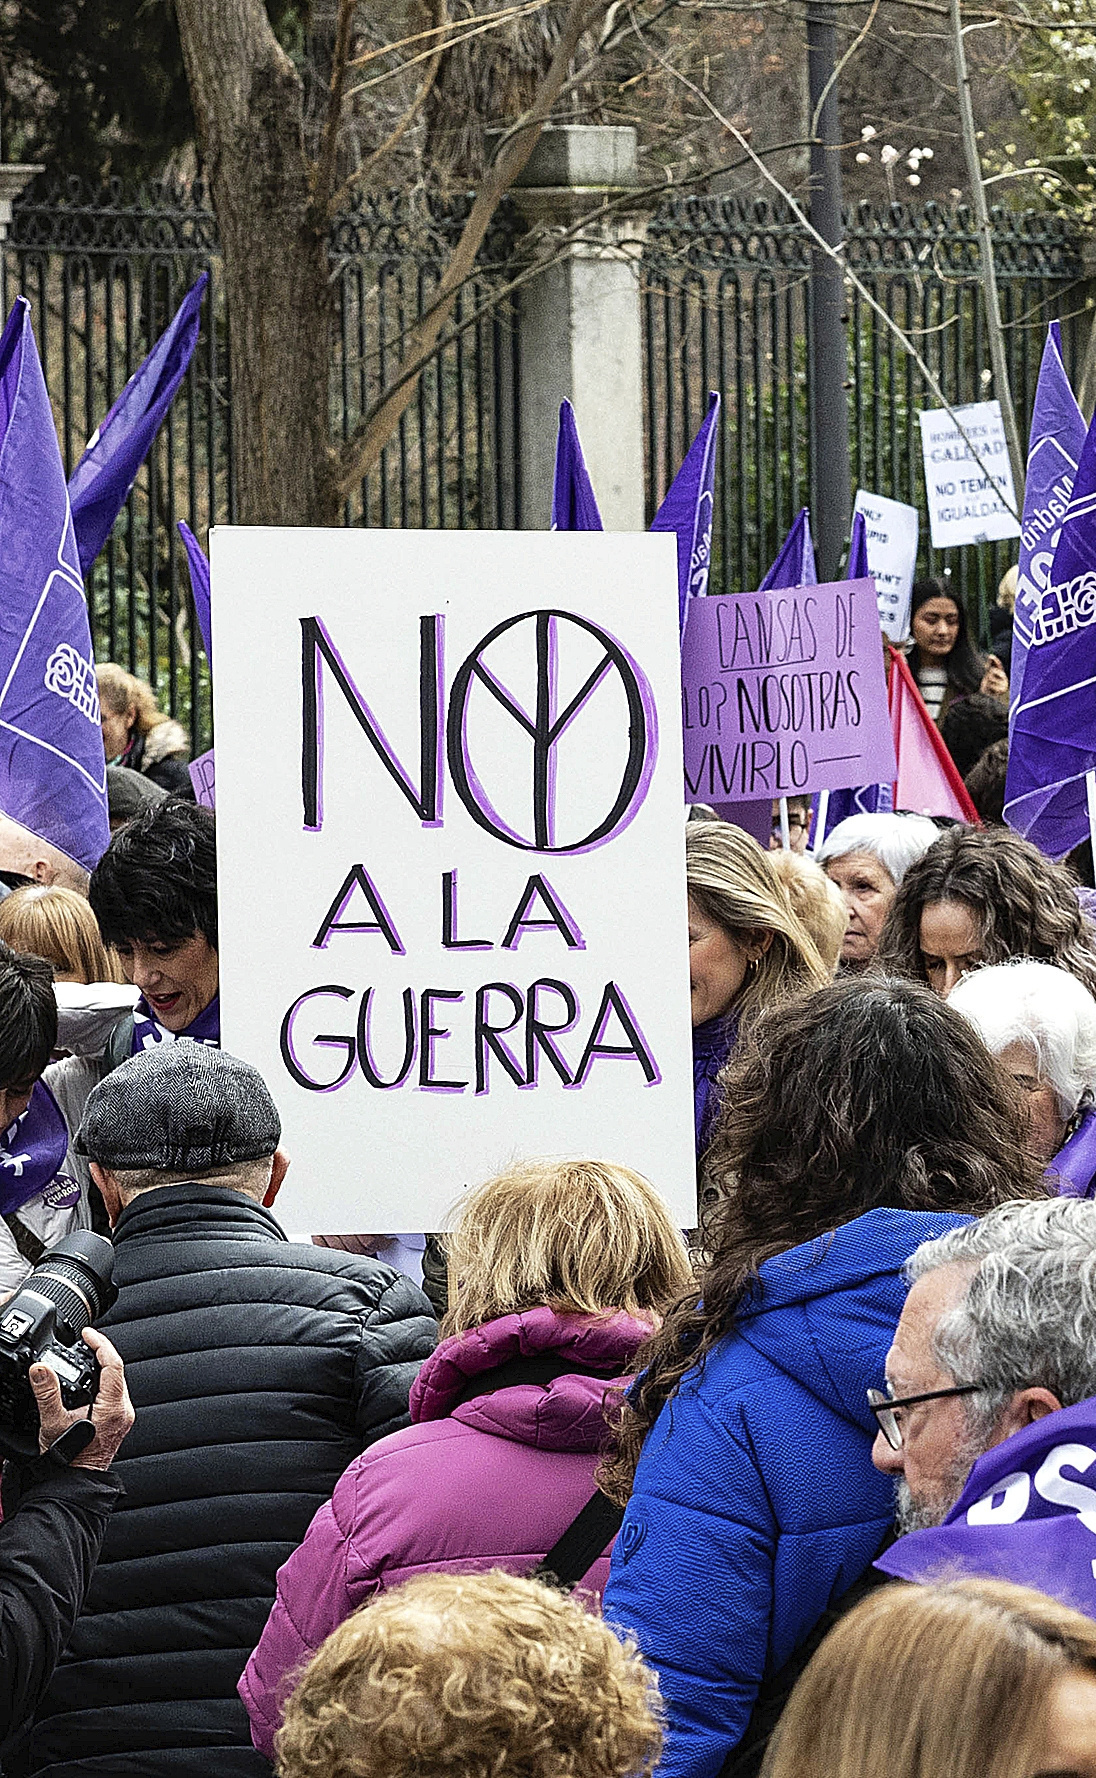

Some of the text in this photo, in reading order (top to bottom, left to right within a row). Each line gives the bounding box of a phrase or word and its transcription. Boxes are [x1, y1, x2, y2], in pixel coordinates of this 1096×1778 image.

[935, 482, 956, 497] NO
[715, 592, 857, 670] CANSAS DE
[298, 609, 659, 856] NO
[736, 669, 862, 735] NOSOTRAS
[683, 740, 809, 796] VIVIRLO
[309, 864, 587, 956] A LA
[279, 978, 663, 1097] GUERRA
